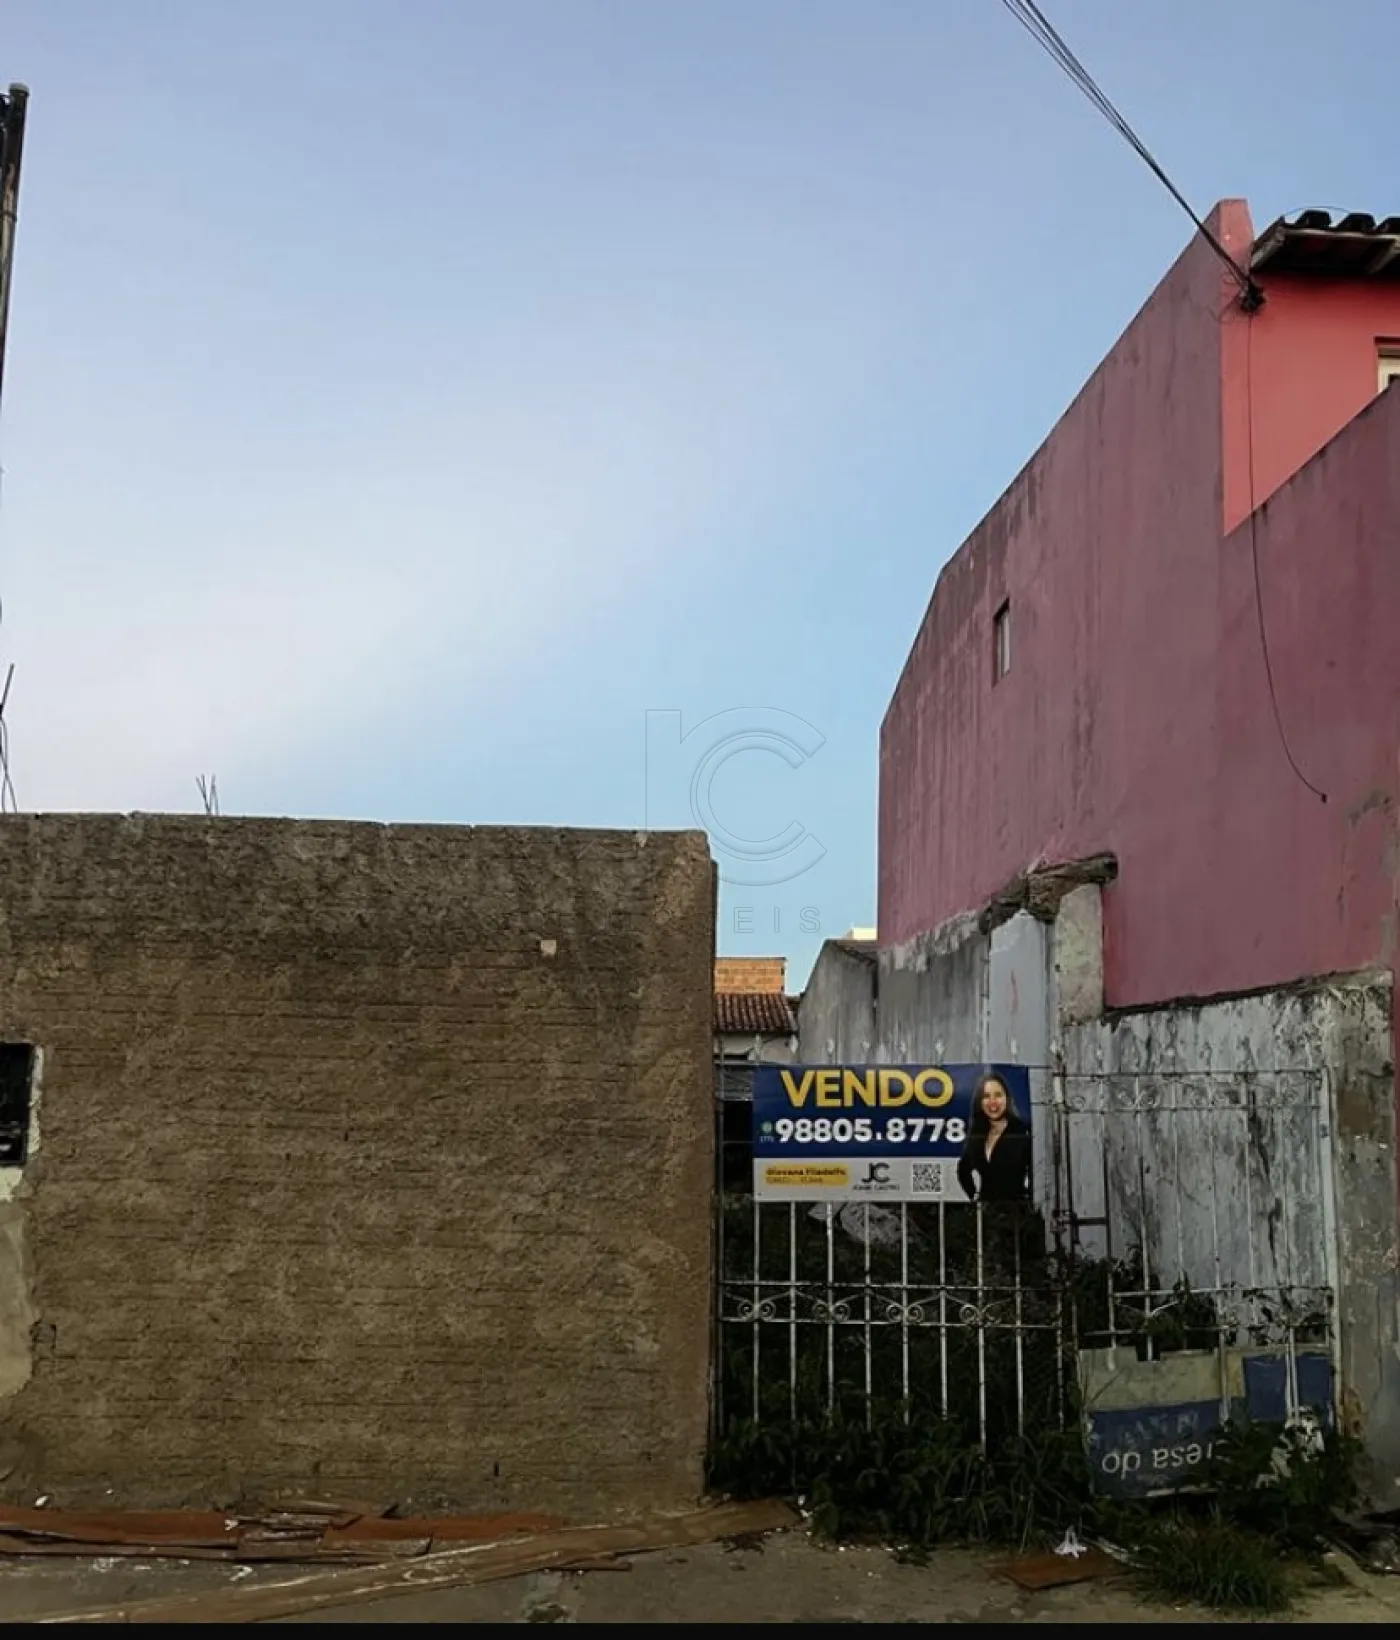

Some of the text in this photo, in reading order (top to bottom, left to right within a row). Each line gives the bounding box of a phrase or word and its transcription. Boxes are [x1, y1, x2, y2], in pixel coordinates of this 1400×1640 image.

[781, 1069, 954, 1108] VENDO
[775, 1118, 965, 1143] 98805.8778
[1102, 1451, 1141, 1480] do
